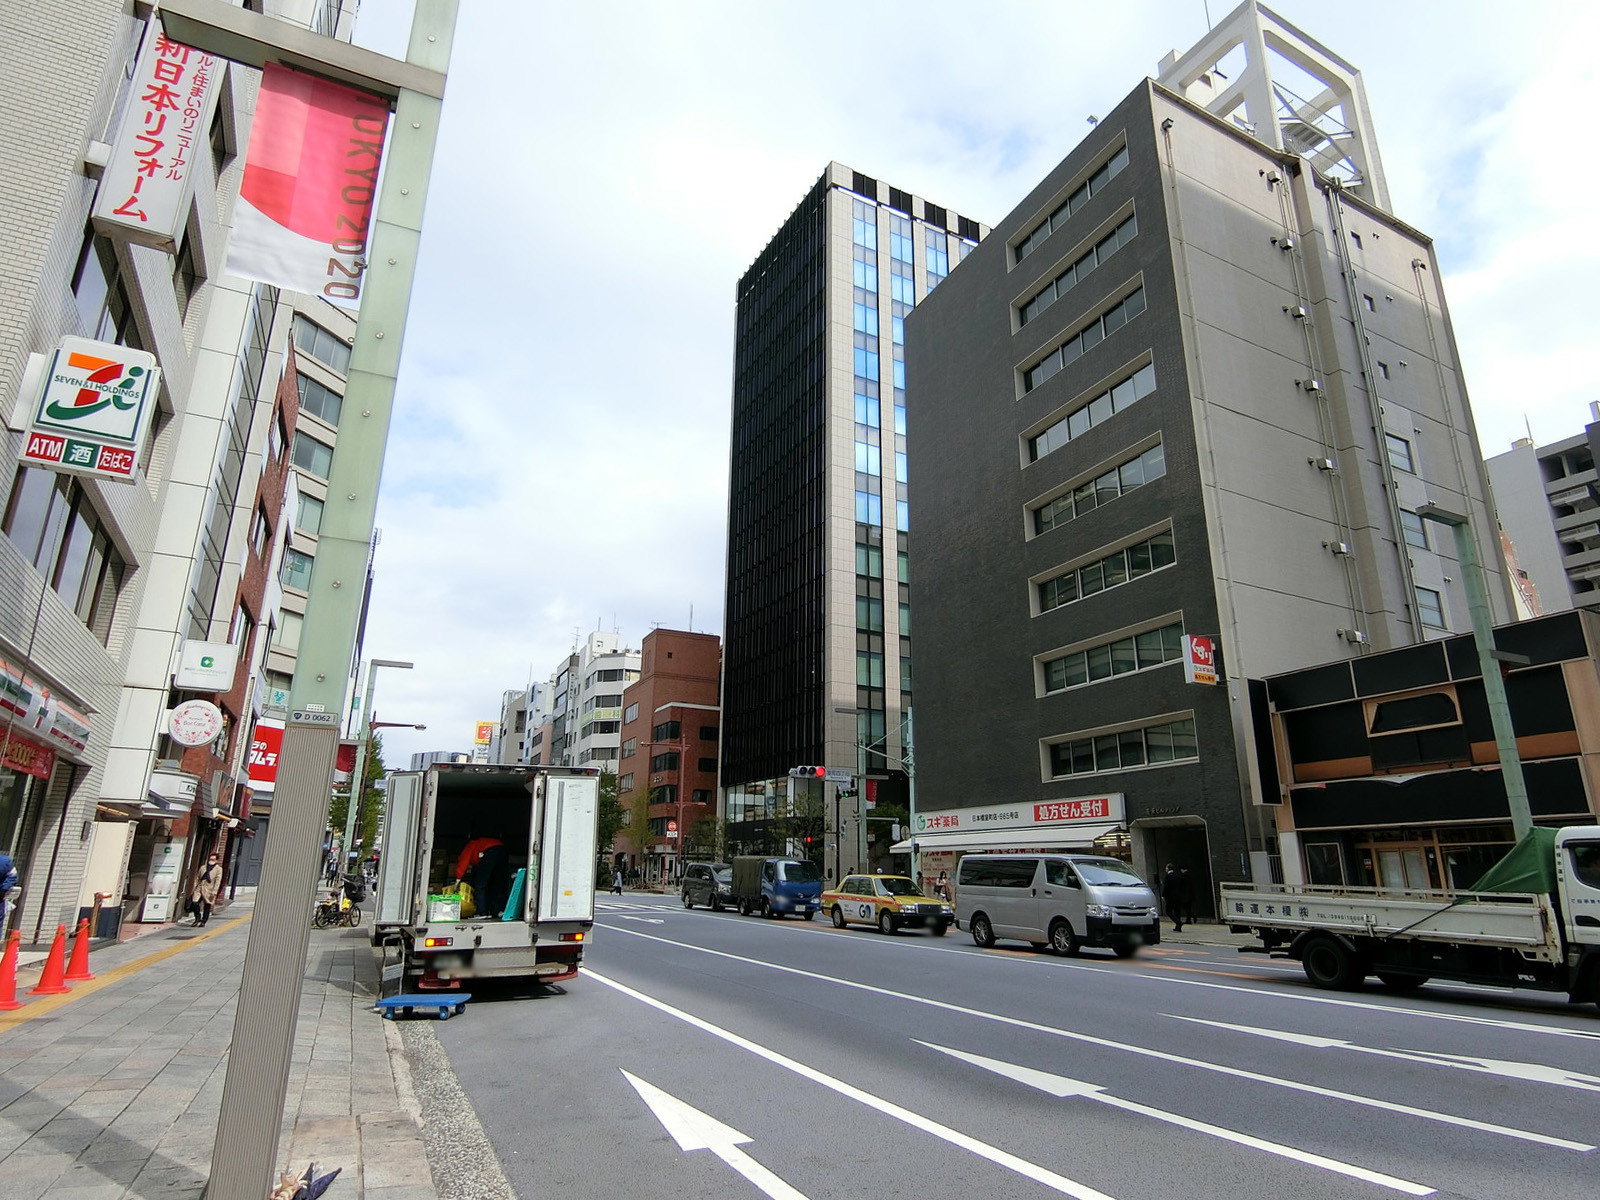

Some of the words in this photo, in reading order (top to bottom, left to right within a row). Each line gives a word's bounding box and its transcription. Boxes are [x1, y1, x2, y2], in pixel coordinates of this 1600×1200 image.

[113, 32, 195, 222] 新日本リフォーム
[165, 50, 214, 182] ルと住まいのリニューアル
[341, 96, 392, 206] TOKYO
[323, 213, 372, 300] 2020
[94, 384, 140, 399] HOLDINGS
[28, 438, 62, 458] ATM
[69, 443, 94, 463] 酒
[100, 450, 132, 470] たばこ
[312, 714, 331, 722] 0062
[926, 815, 959, 829] スギ薬局
[1038, 799, 1103, 821] 処方せん受付
